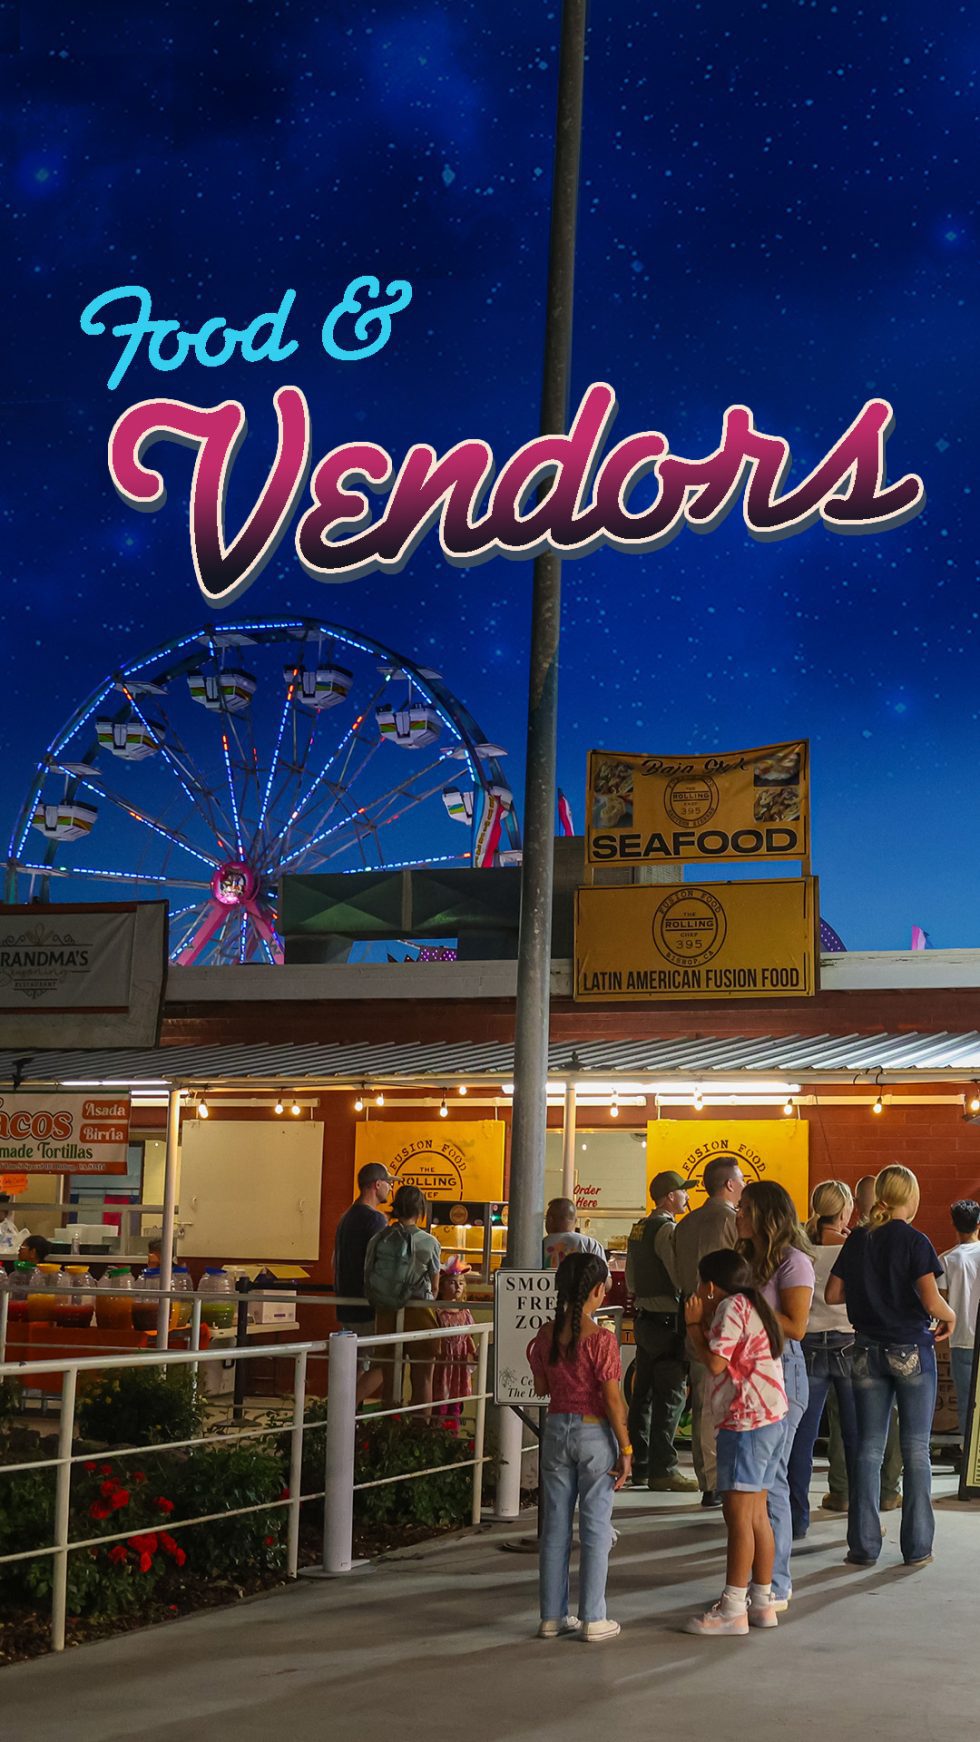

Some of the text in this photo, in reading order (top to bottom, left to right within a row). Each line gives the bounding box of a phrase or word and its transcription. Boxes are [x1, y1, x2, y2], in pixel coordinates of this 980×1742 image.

[641, 758, 694, 776] Baja
[672, 792, 710, 800] ROLLING
[681, 806, 702, 816] 395
[592, 828, 798, 859] SEAFOOD
[659, 890, 722, 914] FUSION FOOD
[665, 920, 714, 929] ROLLING
[676, 939, 703, 949] 395
[0, 949, 89, 967] RANDMA'S
[703, 949, 715, 960] CA
[583, 967, 800, 991] LATIN AMERICAN FUSION FOOD
[85, 1102, 126, 1116] Asada
[0, 1097, 73, 1141] acos
[83, 1125, 124, 1141] Birria
[0, 1142, 94, 1159] made Tortillas
[389, 1140, 467, 1172] FUSION FOOD
[682, 1139, 766, 1172] FUSION FOOD
[398, 1177, 457, 1187] ROLLING
[573, 1184, 602, 1195] Order
[576, 1197, 598, 1208] Here
[506, 1277, 557, 1292] SMO
[517, 1296, 558, 1310] FRE
[515, 1314, 554, 1329] ZO
[508, 1388, 526, 1398] The
